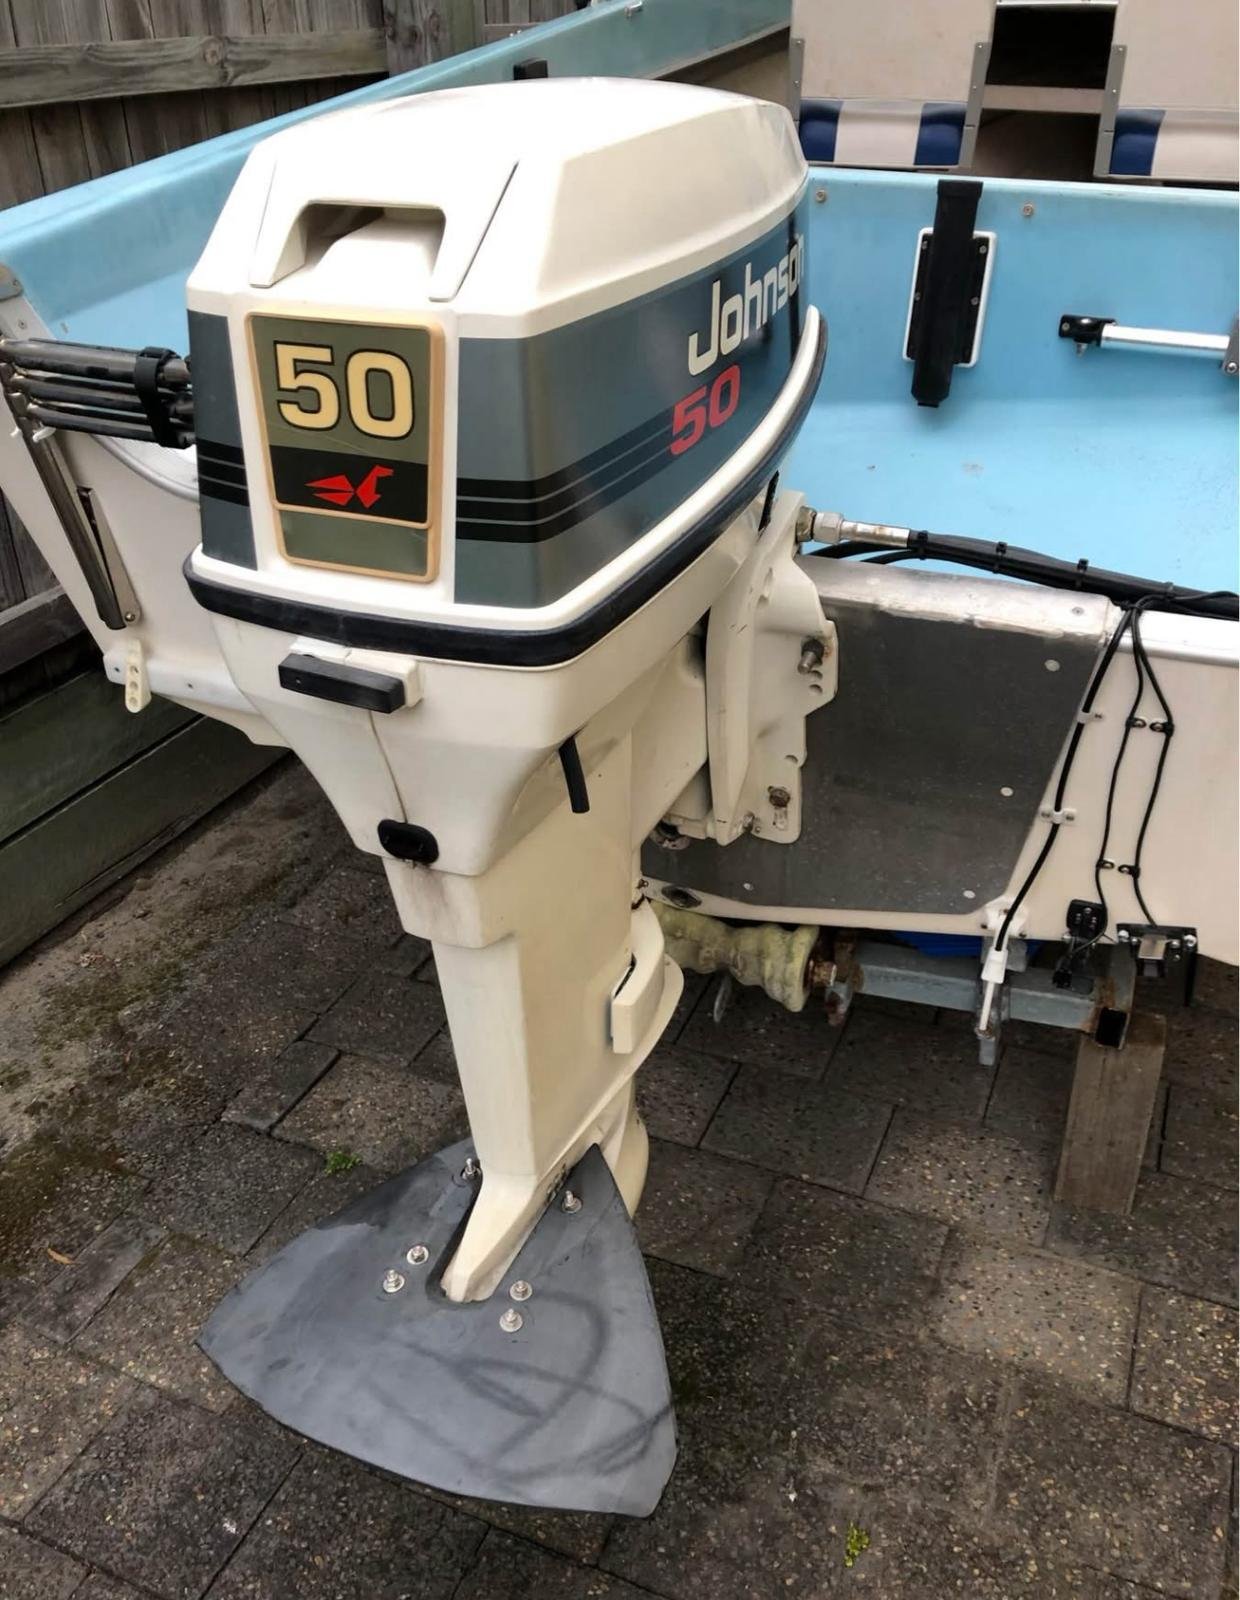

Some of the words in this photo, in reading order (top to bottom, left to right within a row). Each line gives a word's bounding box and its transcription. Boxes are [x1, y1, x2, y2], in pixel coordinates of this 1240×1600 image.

[688, 234, 804, 376] Johnson
[274, 341, 414, 440] 50
[670, 365, 741, 455] 50
